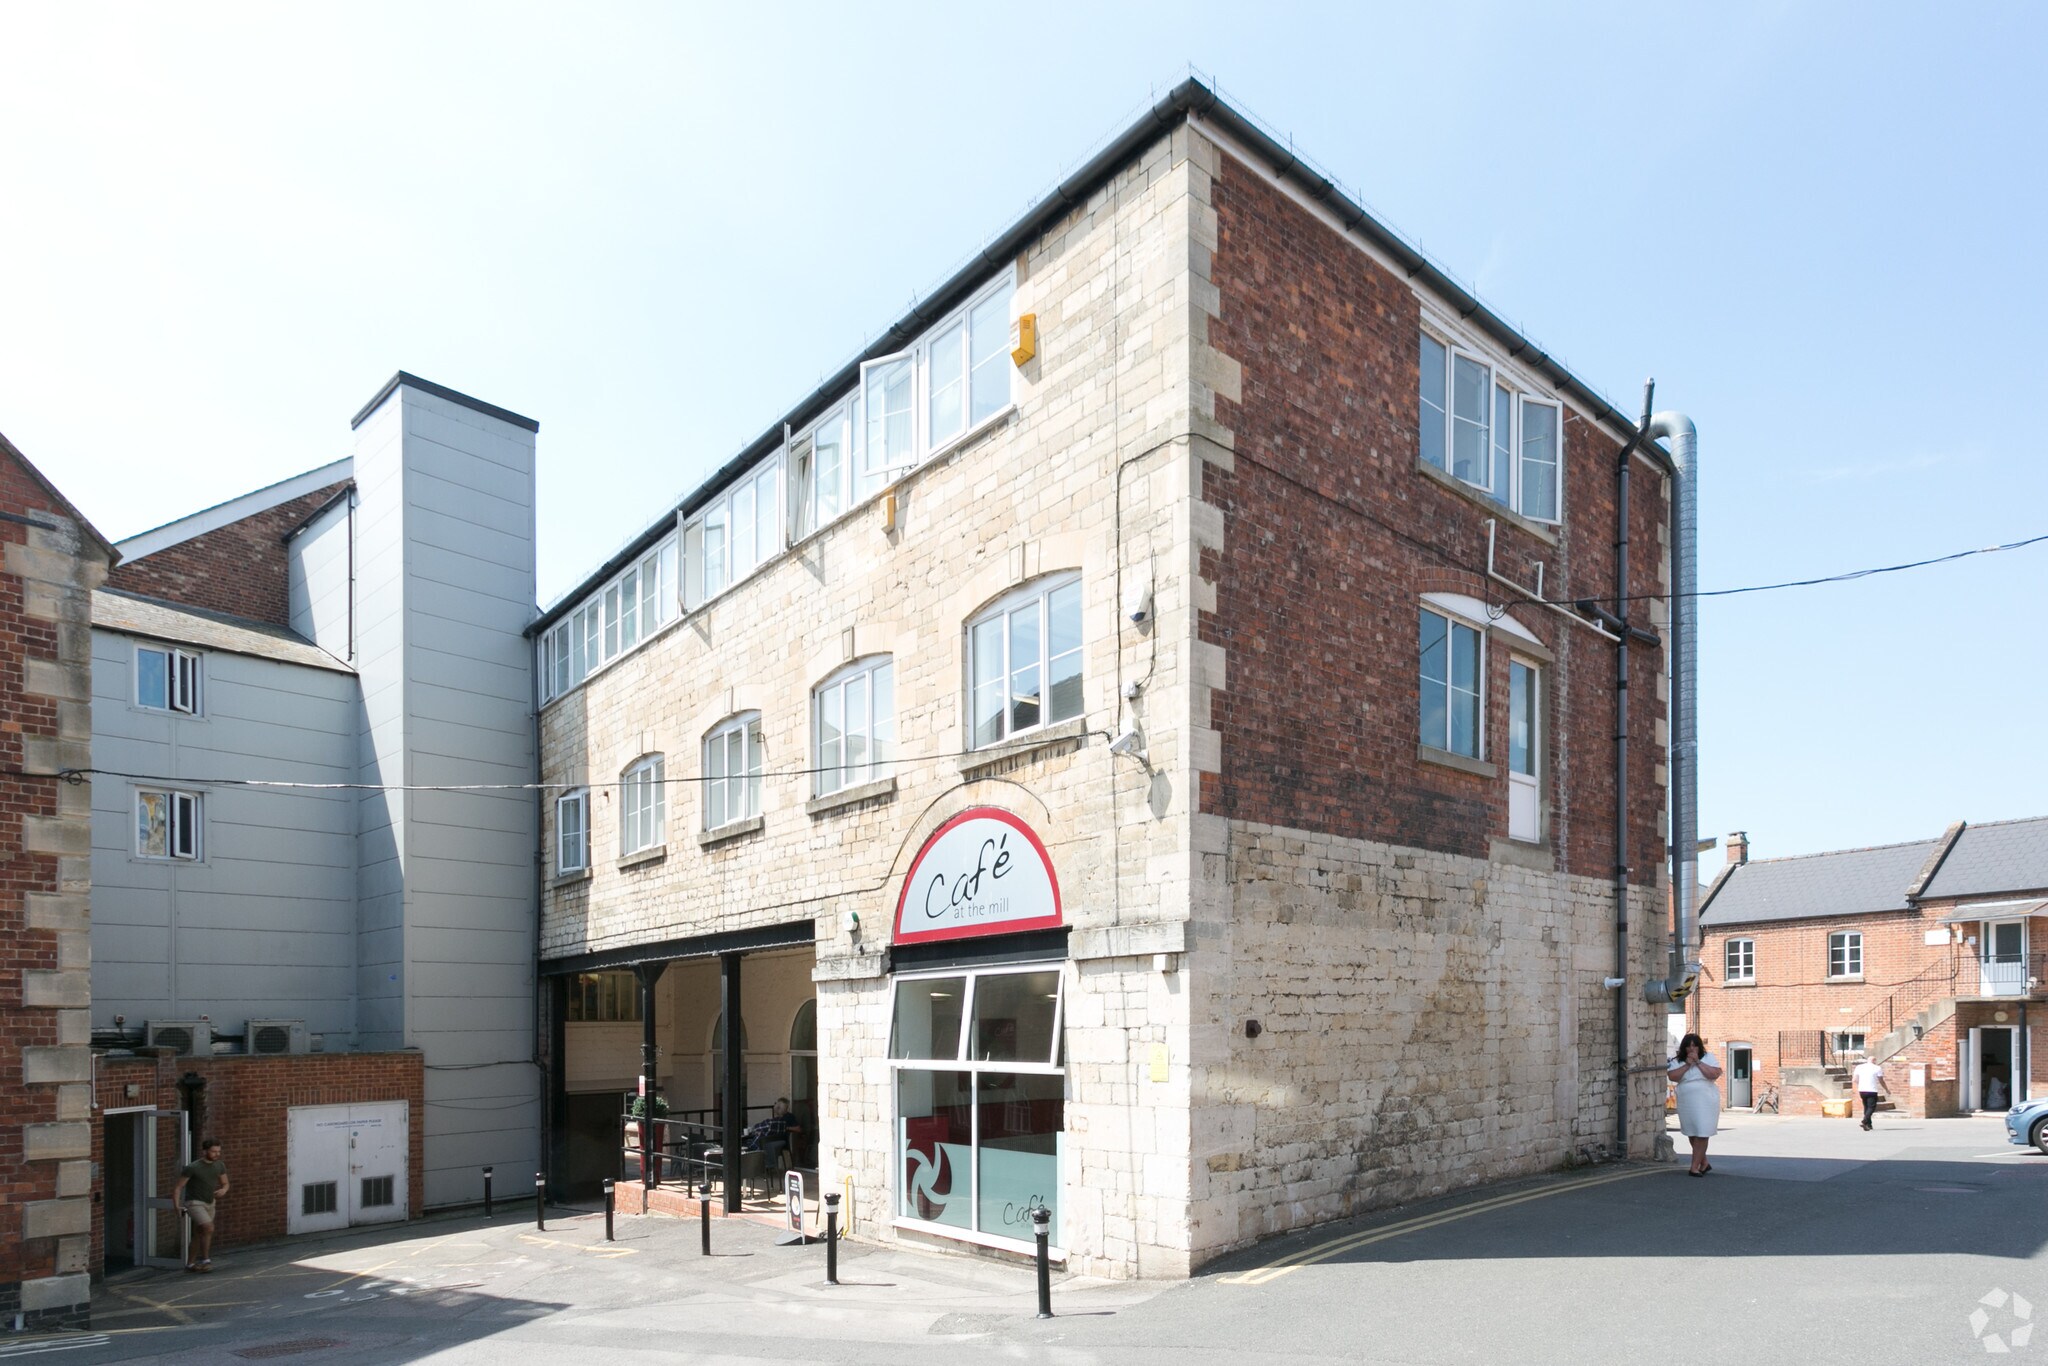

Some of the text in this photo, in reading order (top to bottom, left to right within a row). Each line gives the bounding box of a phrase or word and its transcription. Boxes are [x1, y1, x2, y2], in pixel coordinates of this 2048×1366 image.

[926, 833, 1014, 918] Café
[954, 897, 1009, 919] at the mill
